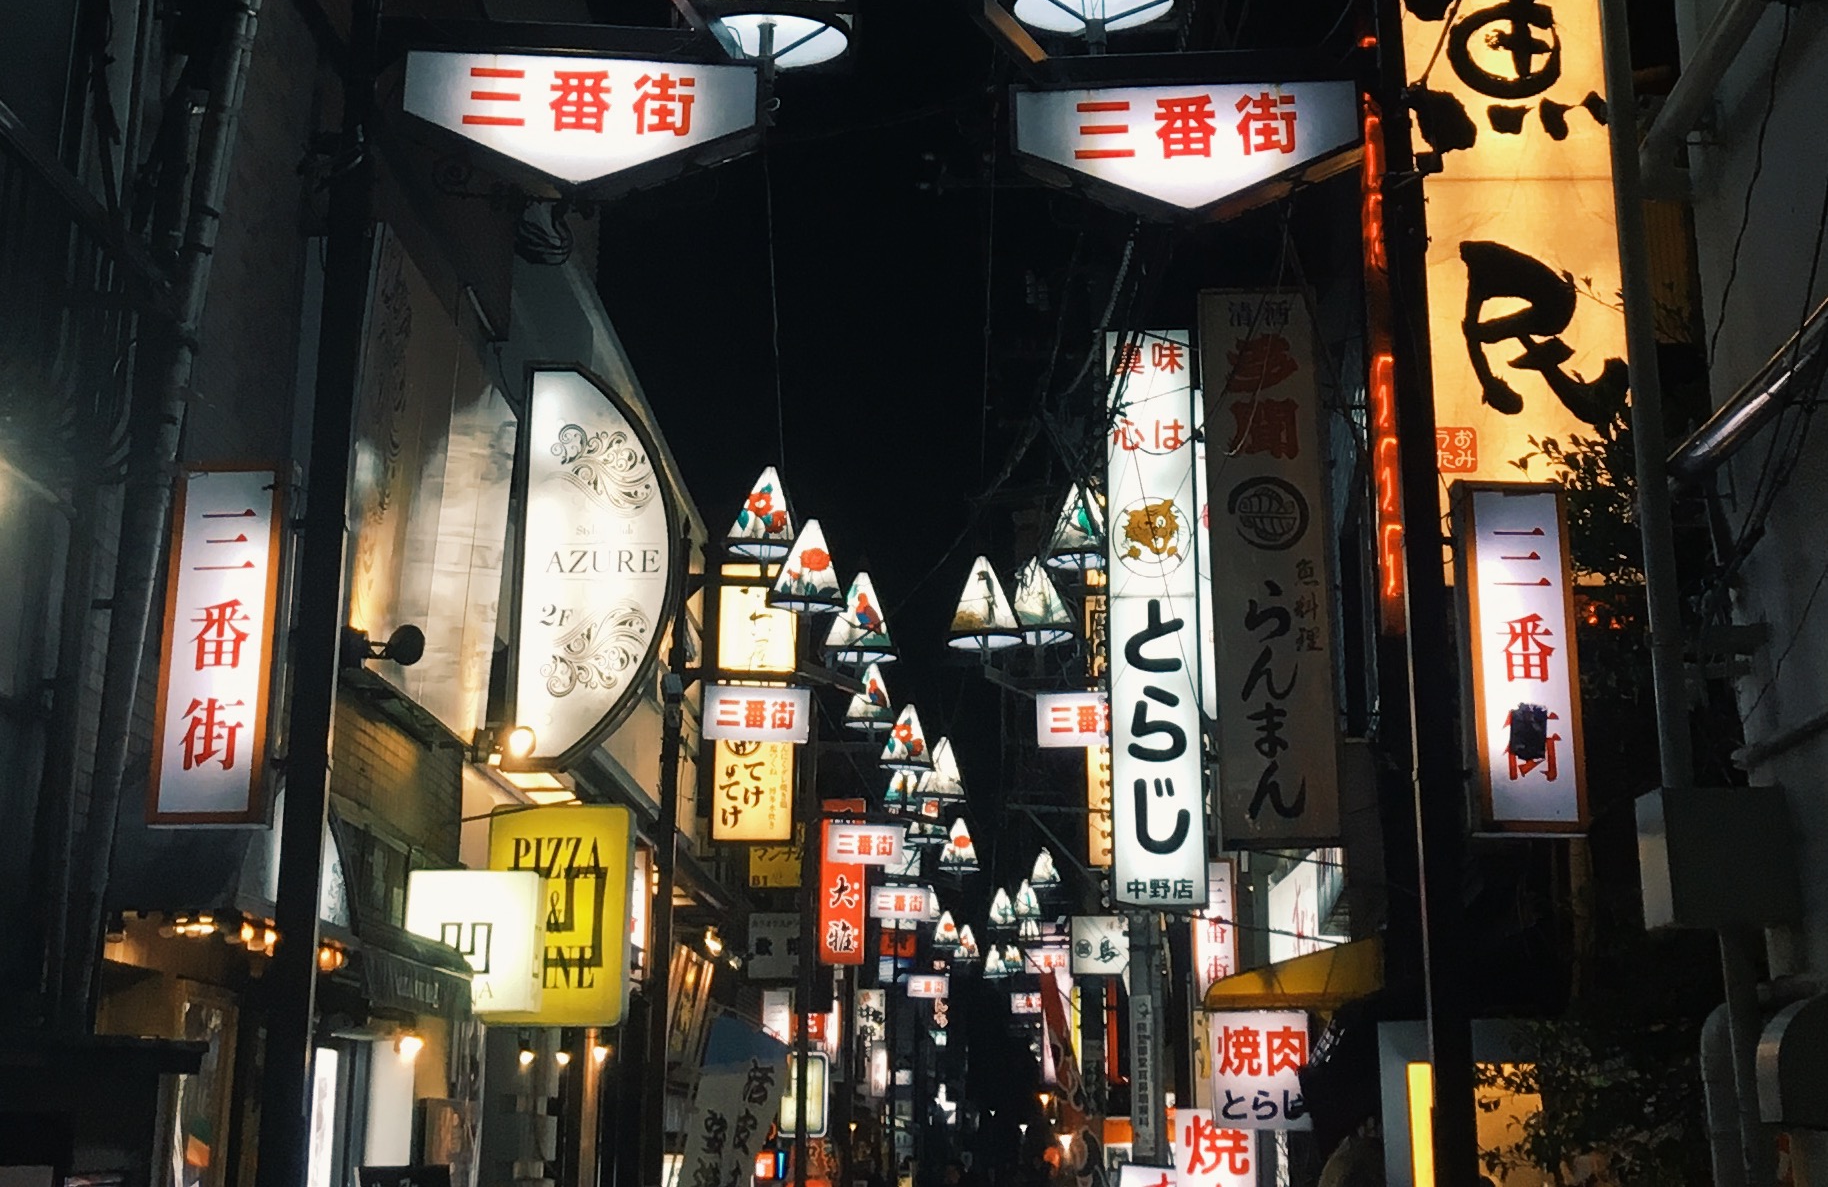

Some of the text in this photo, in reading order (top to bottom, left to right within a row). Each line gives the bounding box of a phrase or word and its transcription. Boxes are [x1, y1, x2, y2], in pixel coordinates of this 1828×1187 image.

[462, 67, 695, 137] 三番街
[1074, 92, 1297, 160] 三番街
[545, 549, 661, 574] AZURE
[540, 603, 575, 627] 2F
[179, 508, 257, 772] 三番街
[716, 699, 796, 730] 三番街
[1241, 580, 1306, 820] らんまん
[1124, 598, 1191, 855] とらじ
[513, 836, 606, 879] PIZZA
[837, 833, 894, 856] 三番街
[877, 894, 924, 912] 三番街
[1126, 878, 1193, 900] 中野店
[546, 890, 563, 934] &
[543, 946, 595, 990] INE
[1217, 1025, 1307, 1077] 焼肉
[1185, 1115, 1250, 1187] 焼
